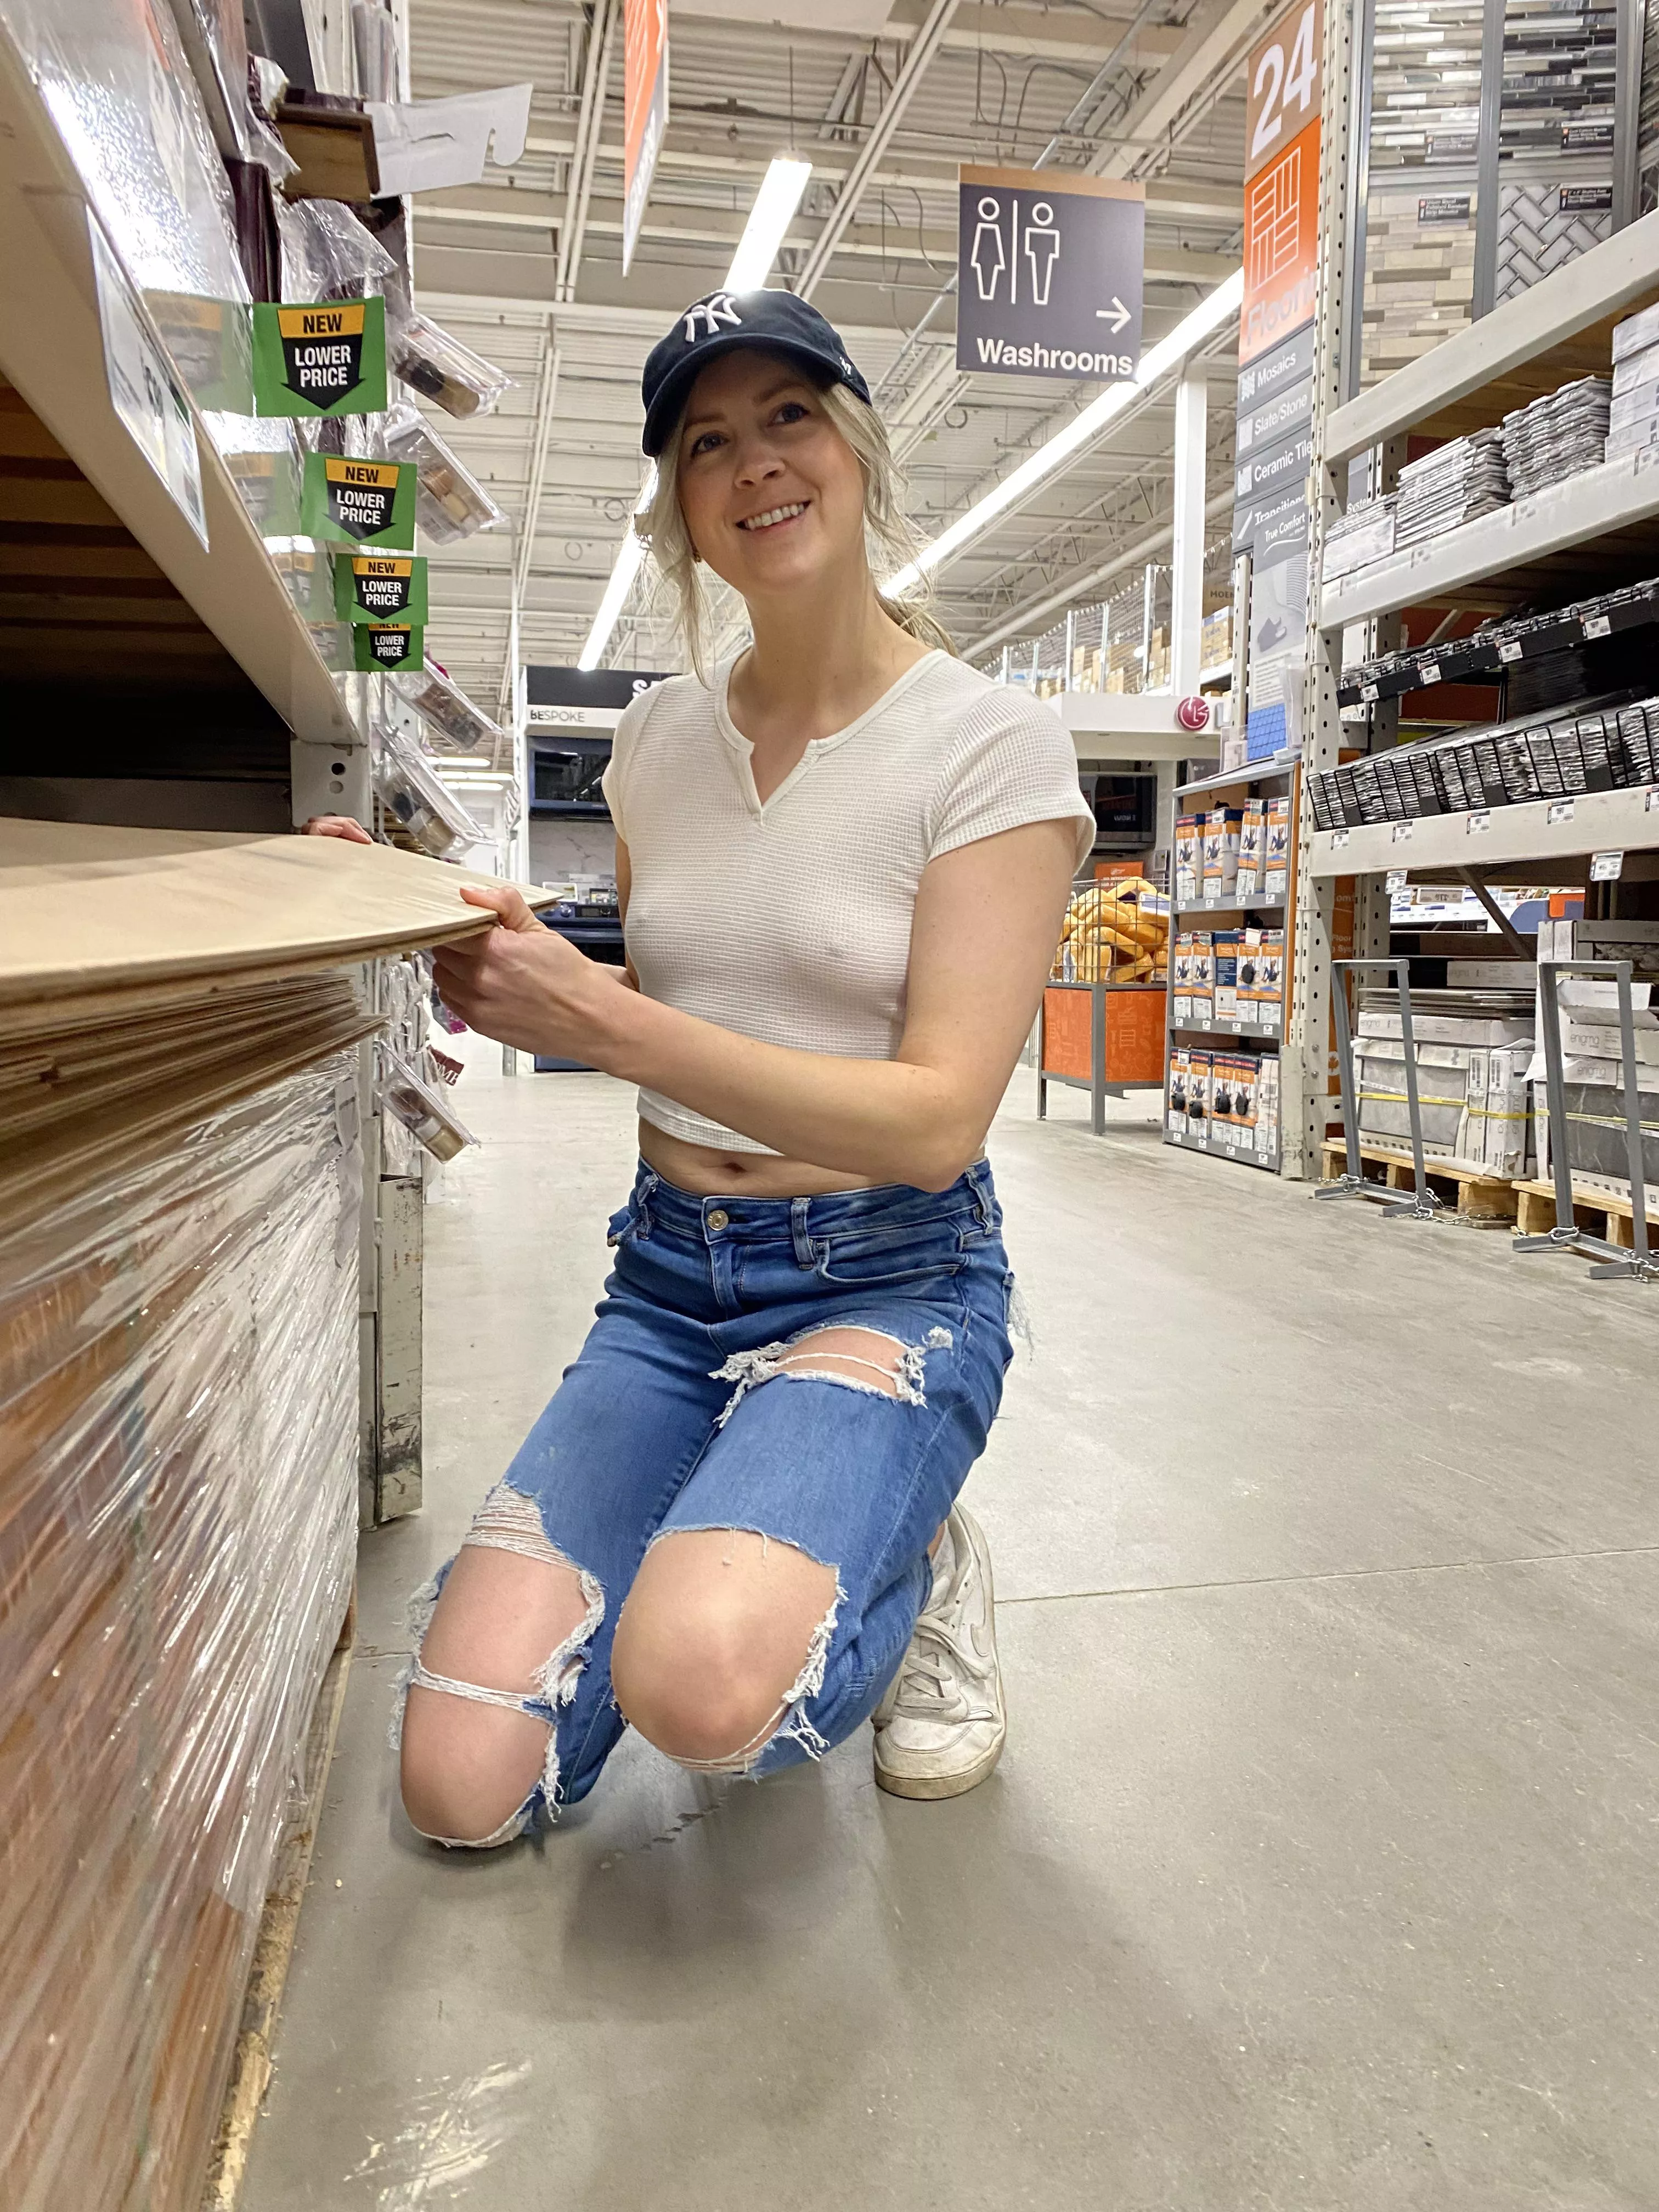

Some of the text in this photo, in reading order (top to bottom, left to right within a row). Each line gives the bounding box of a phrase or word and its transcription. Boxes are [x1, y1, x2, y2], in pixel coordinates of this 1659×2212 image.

[1251, 1, 1317, 160] 24
[303, 313, 342, 334] NEW
[683, 295, 742, 342] NY
[295, 345, 351, 366] LOWER
[977, 337, 1133, 375] Washrooms
[300, 366, 348, 388] PRICE
[1257, 353, 1296, 388] Mosaics
[1255, 393, 1307, 436] Slate/Stone
[1254, 439, 1313, 482] Ceramic Tile
[345, 466, 379, 483] NEW
[336, 489, 385, 510] LOWER
[1347, 498, 1368, 514] Syste
[340, 506, 381, 526] PRICE
[1265, 528, 1278, 542] True
[1279, 512, 1305, 534] Comfort
[368, 561, 396, 574] NEW
[362, 580, 402, 594] LOWER
[365, 593, 399, 606] PRICE
[375, 635, 404, 646] LOWER
[377, 646, 402, 657] PRICE
[531, 709, 585, 723] BESPOKE
[1178, 696, 1210, 731] LG
